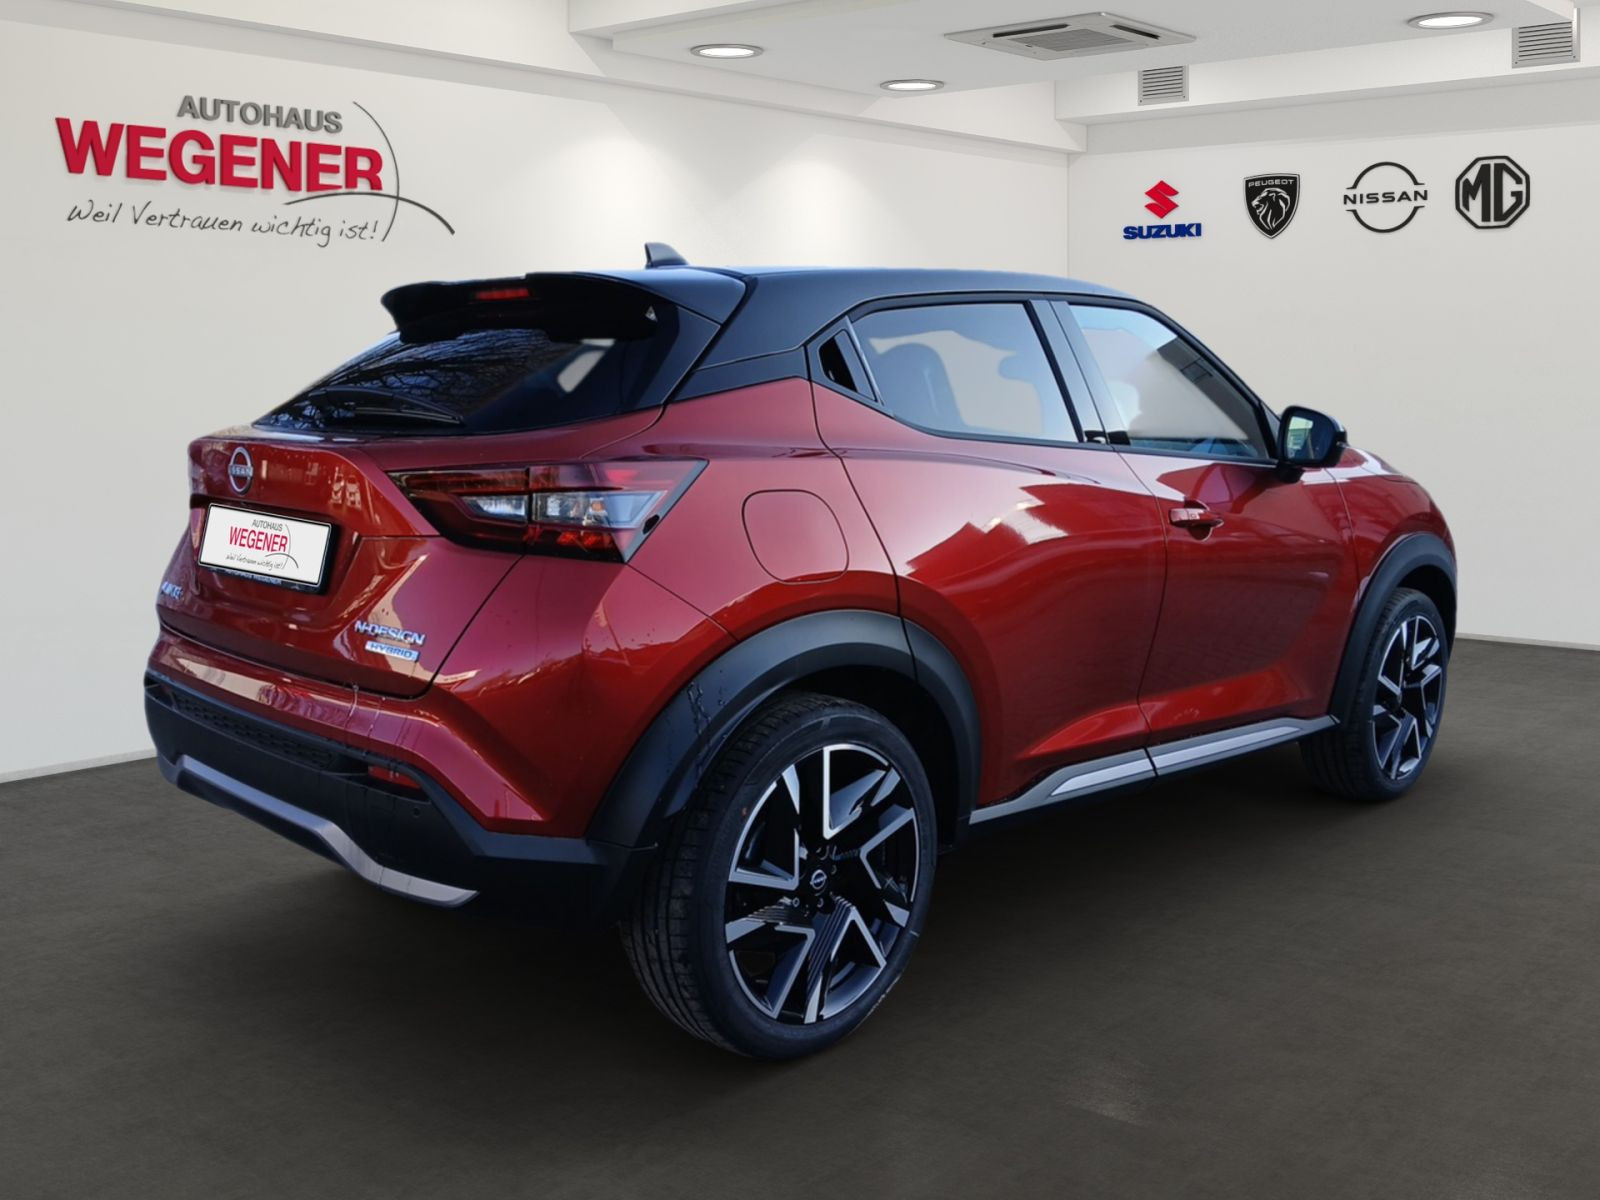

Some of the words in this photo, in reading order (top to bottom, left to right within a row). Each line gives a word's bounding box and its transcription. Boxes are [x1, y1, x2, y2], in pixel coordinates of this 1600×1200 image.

[177, 95, 343, 134] AUTOHAUS
[55, 117, 383, 192] WEGENER
[1248, 178, 1295, 188] PEUGEOT
[1461, 163, 1524, 223] MG
[1343, 189, 1428, 206] NISSAN
[67, 199, 123, 223] Weil
[132, 200, 242, 232] Vertrauen
[251, 216, 331, 248] wichtig
[340, 220, 378, 240] ist!
[1123, 223, 1202, 240] SUZUKI
[252, 519, 283, 532] AUTOHAUS
[229, 526, 288, 553] WEGENER
[354, 620, 426, 646] N-DESIGN
[370, 642, 413, 658] HYBRID
